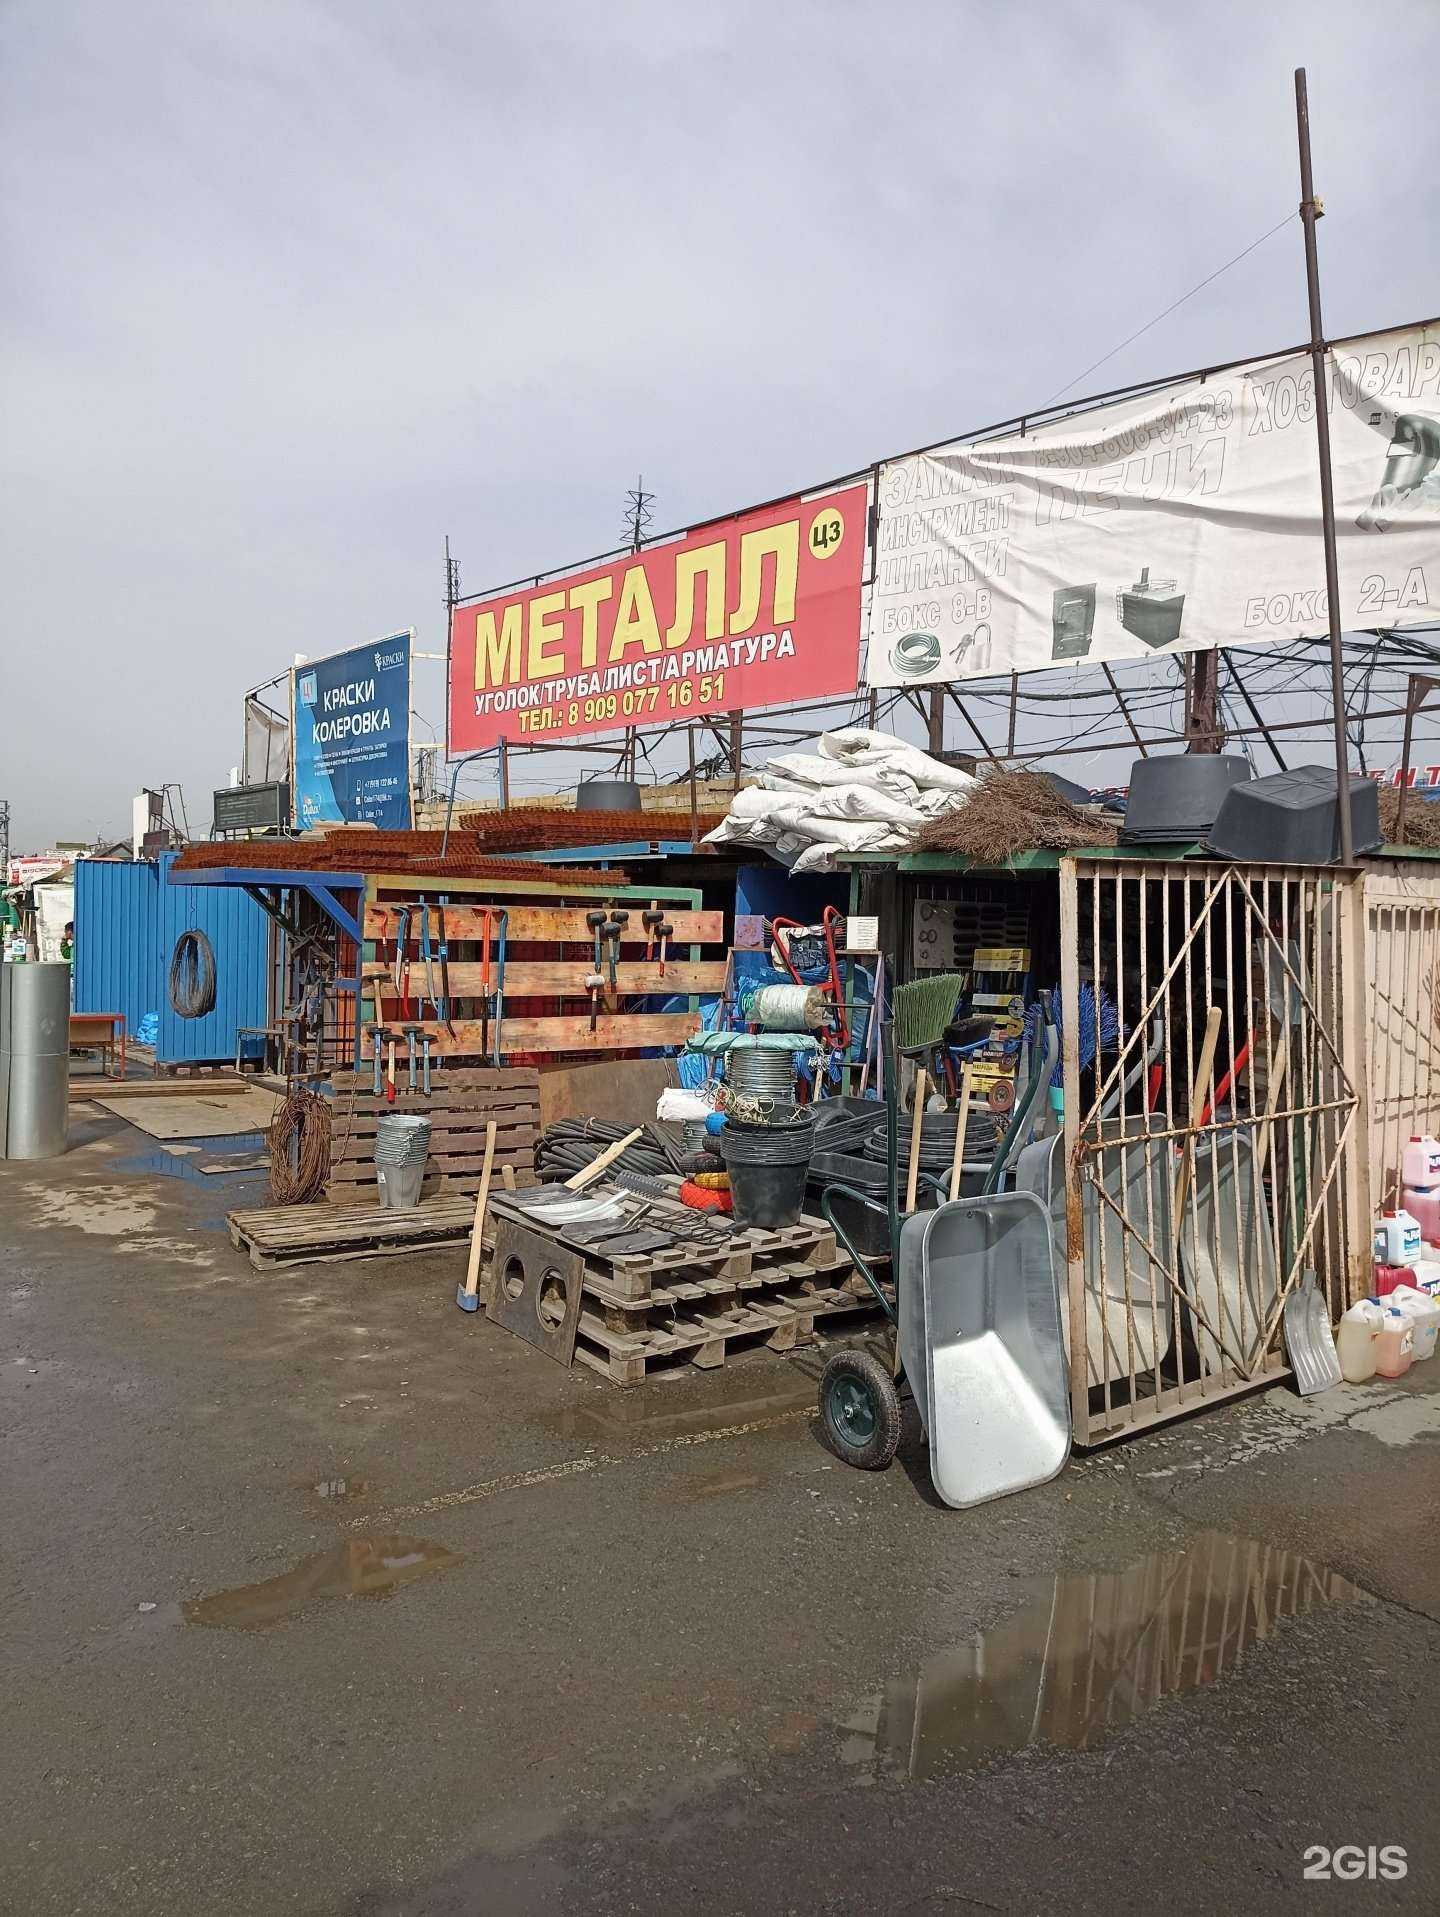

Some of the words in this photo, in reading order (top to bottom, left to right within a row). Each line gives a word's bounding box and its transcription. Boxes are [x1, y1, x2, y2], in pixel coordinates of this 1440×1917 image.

[1248, 342, 1440, 436] ХОЗТОВАР
[1034, 437, 1225, 526] ПЕЧИ
[881, 493, 1015, 552] ИНСТРУМЕНТ
[878, 537, 1009, 597] ШЛАНГИ
[1357, 567, 1429, 614] 2-А
[473, 519, 800, 690] МЕТАЛЛ
[883, 601, 941, 634] БОКС
[323, 679, 375, 712] КРАСКИ
[519, 709, 563, 734] ТЕЛ.:
[568, 702, 579, 726] 8
[584, 694, 617, 723] 909
[622, 686, 661, 716] 077
[667, 680, 693, 709] 16
[699, 673, 725, 704] 51
[312, 707, 391, 744] КОЛЕРОВКА
